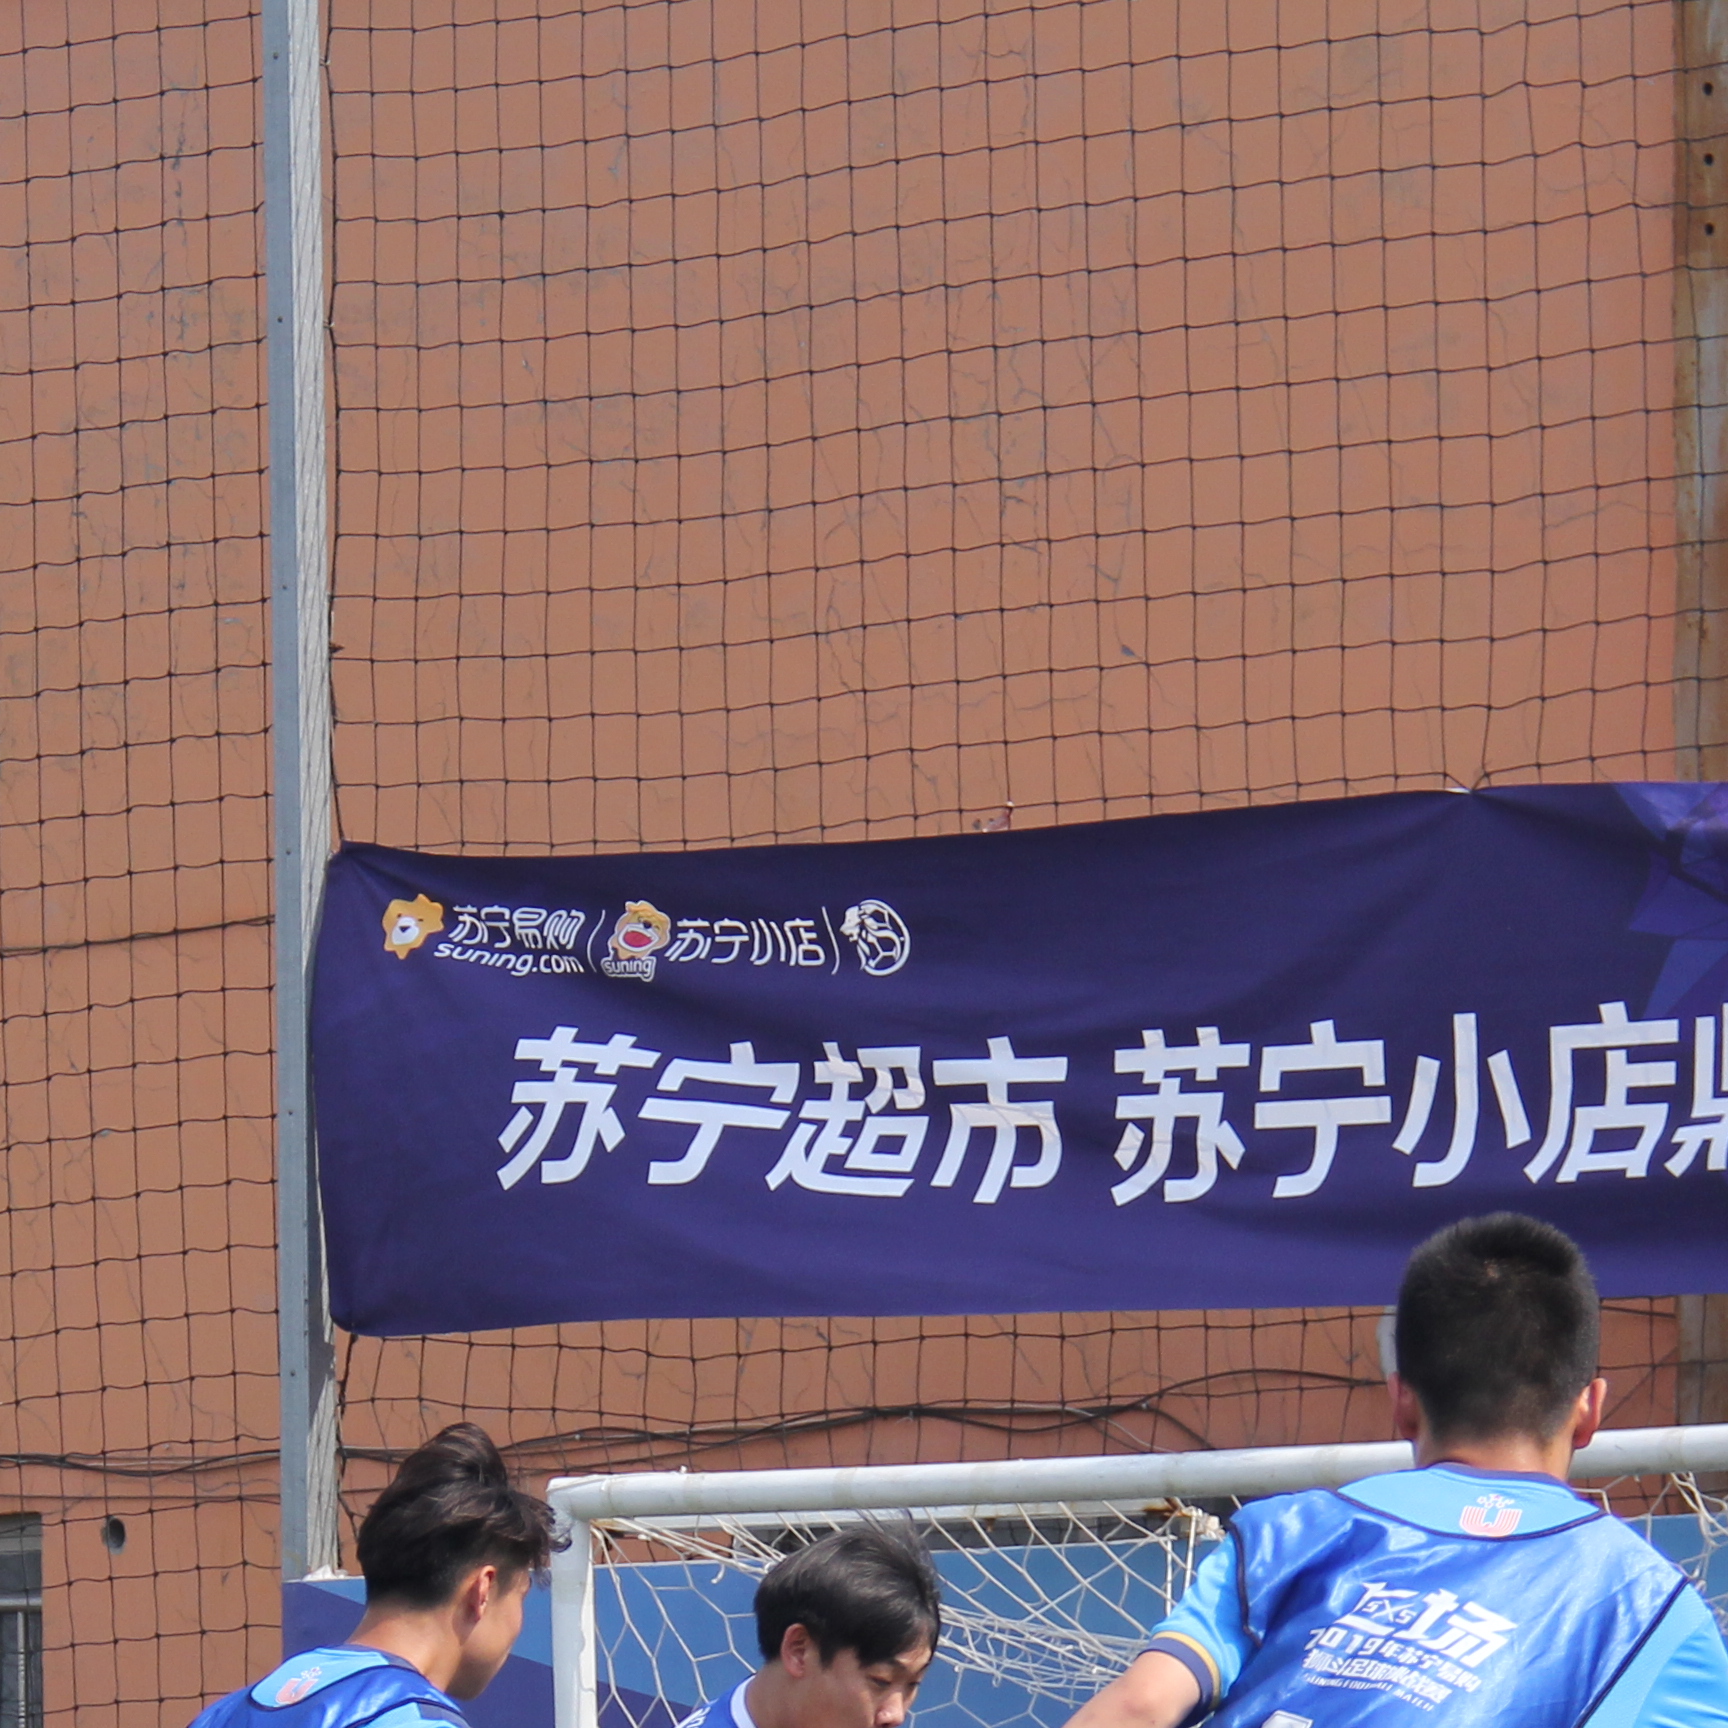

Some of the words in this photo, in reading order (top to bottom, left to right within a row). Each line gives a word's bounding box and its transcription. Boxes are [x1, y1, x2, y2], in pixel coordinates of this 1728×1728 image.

[449, 904, 586, 951] 苏宁易购
[668, 918, 825, 967] 苏宁小店
[433, 942, 584, 977] suning.com
[603, 957, 653, 979] suning
[496, 1025, 1070, 1205] 苏宁超市
